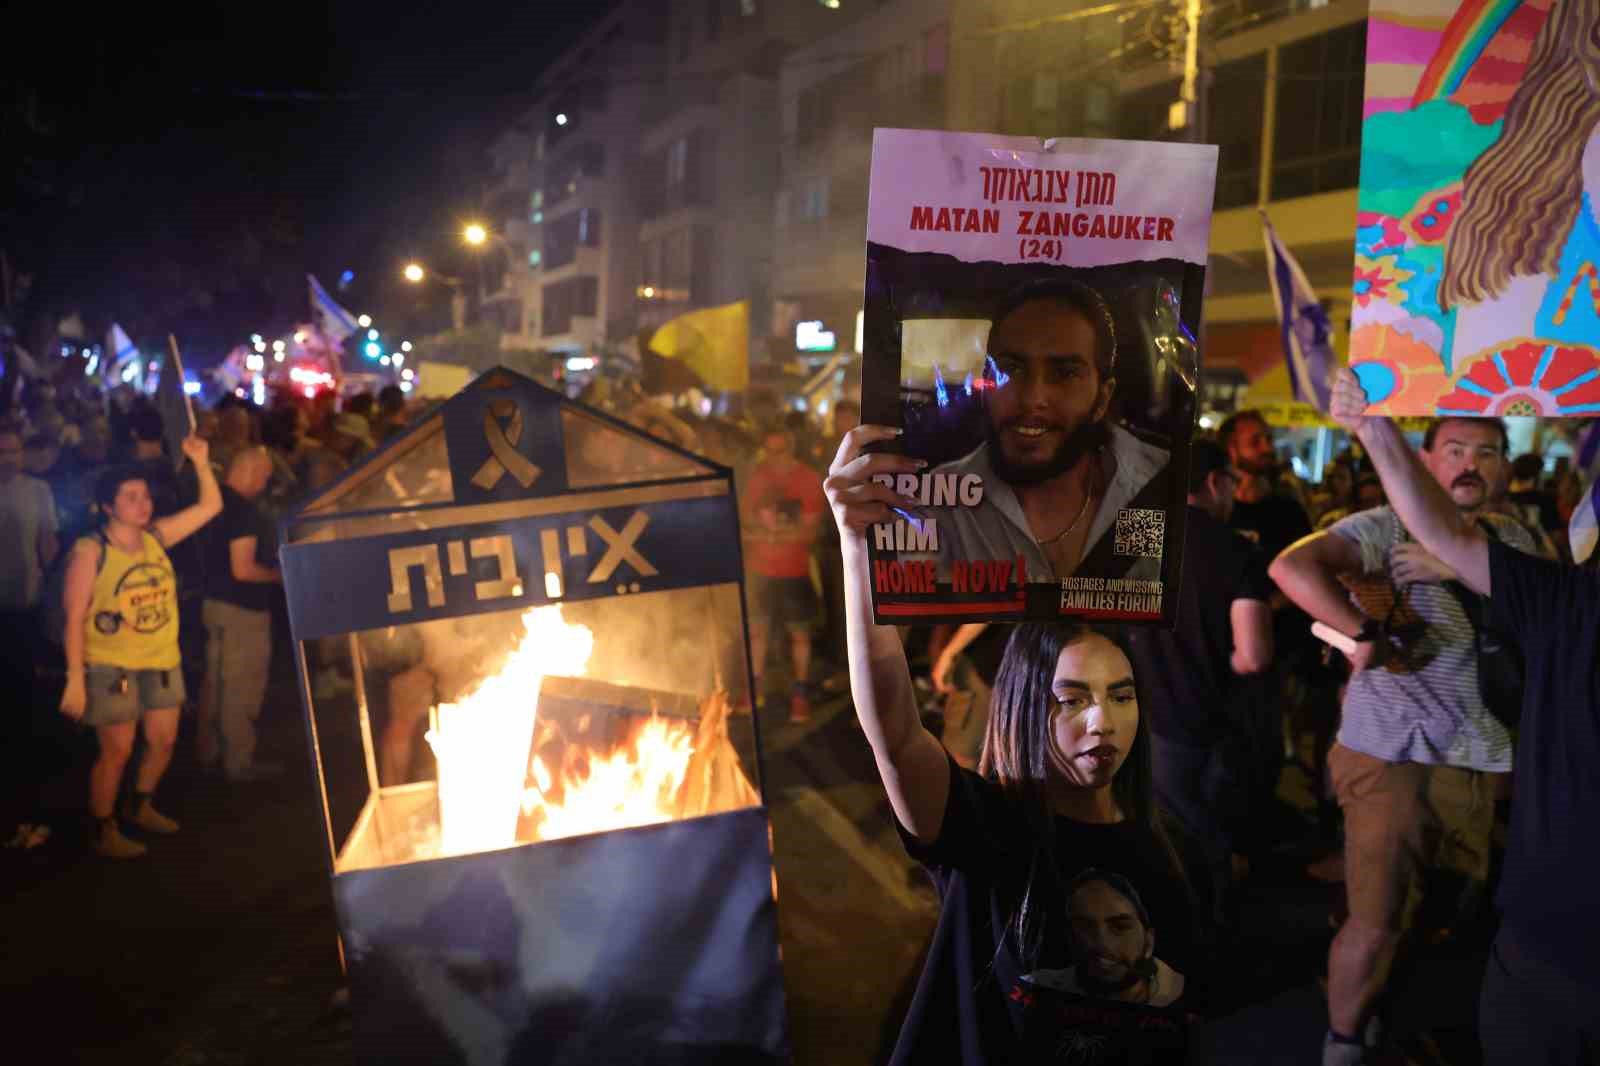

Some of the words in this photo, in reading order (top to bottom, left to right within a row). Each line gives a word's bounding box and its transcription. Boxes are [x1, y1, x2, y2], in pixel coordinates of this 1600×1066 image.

[979, 166, 1071, 205] צנגאוקר
[1075, 170, 1117, 209] מתן
[910, 206, 1000, 234] MATAN
[1017, 210, 1175, 241] ZANGAUKER
[1020, 239, 1063, 260] (24)
[874, 518, 939, 551] HIM
[387, 534, 525, 614] בית
[875, 560, 936, 593] HOME
[1061, 577, 1105, 591] HOSTAGES
[1106, 578, 1122, 593] AND
[1122, 579, 1164, 595] MISSING
[1060, 591, 1115, 610] FAMILIES
[1118, 593, 1162, 614] FORUM
